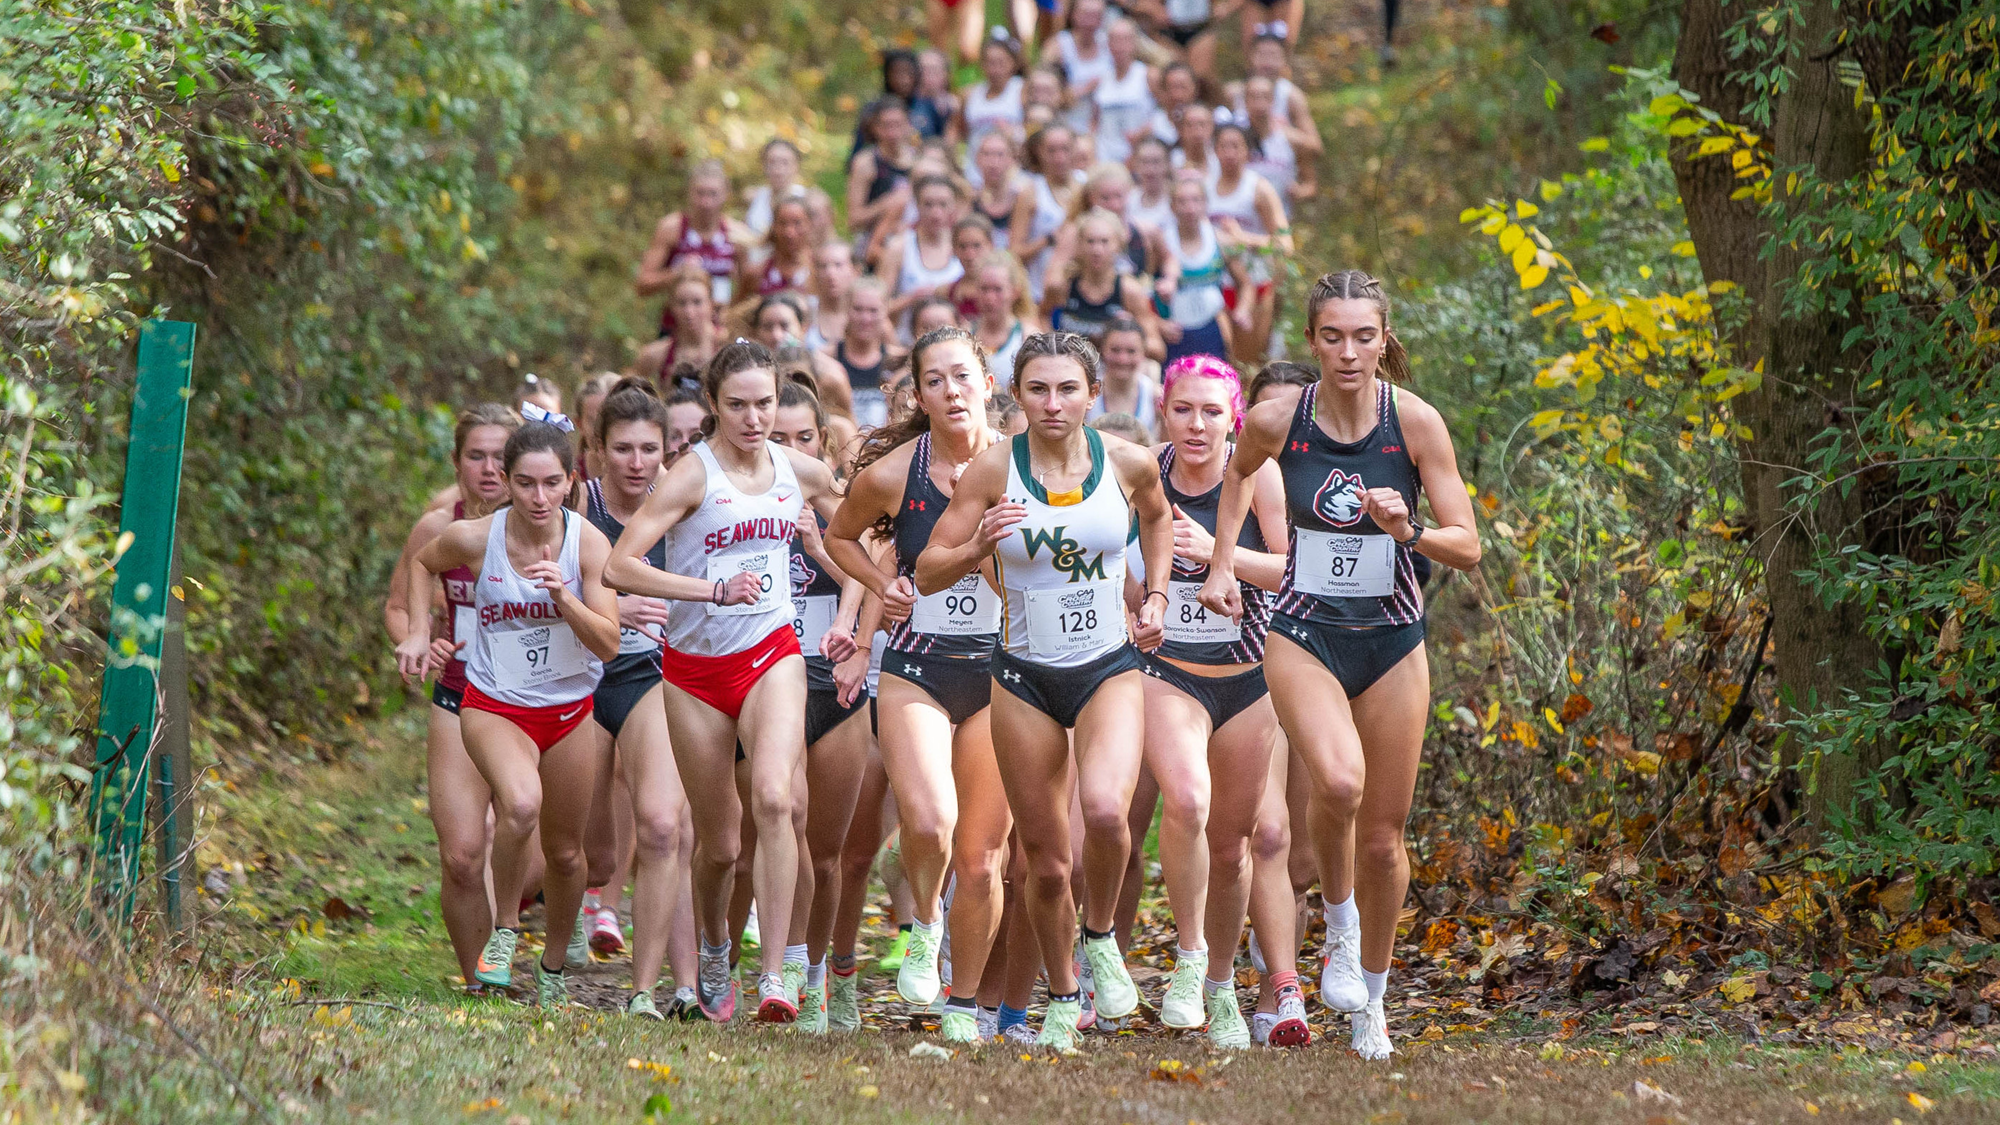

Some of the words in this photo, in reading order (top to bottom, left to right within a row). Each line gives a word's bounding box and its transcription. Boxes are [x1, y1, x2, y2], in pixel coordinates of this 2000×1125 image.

[1017, 524, 1109, 584] W&M
[1331, 556, 1359, 578] 87
[1321, 587, 1367, 595] Northeastern
[945, 595, 978, 616] 90
[1180, 604, 1207, 624] 84
[938, 625, 983, 633] Northeastern
[1059, 609, 1098, 633] 128
[1068, 634, 1092, 643] Istnick
[1172, 633, 1216, 641] Northeastern
[526, 646, 550, 669] 97
